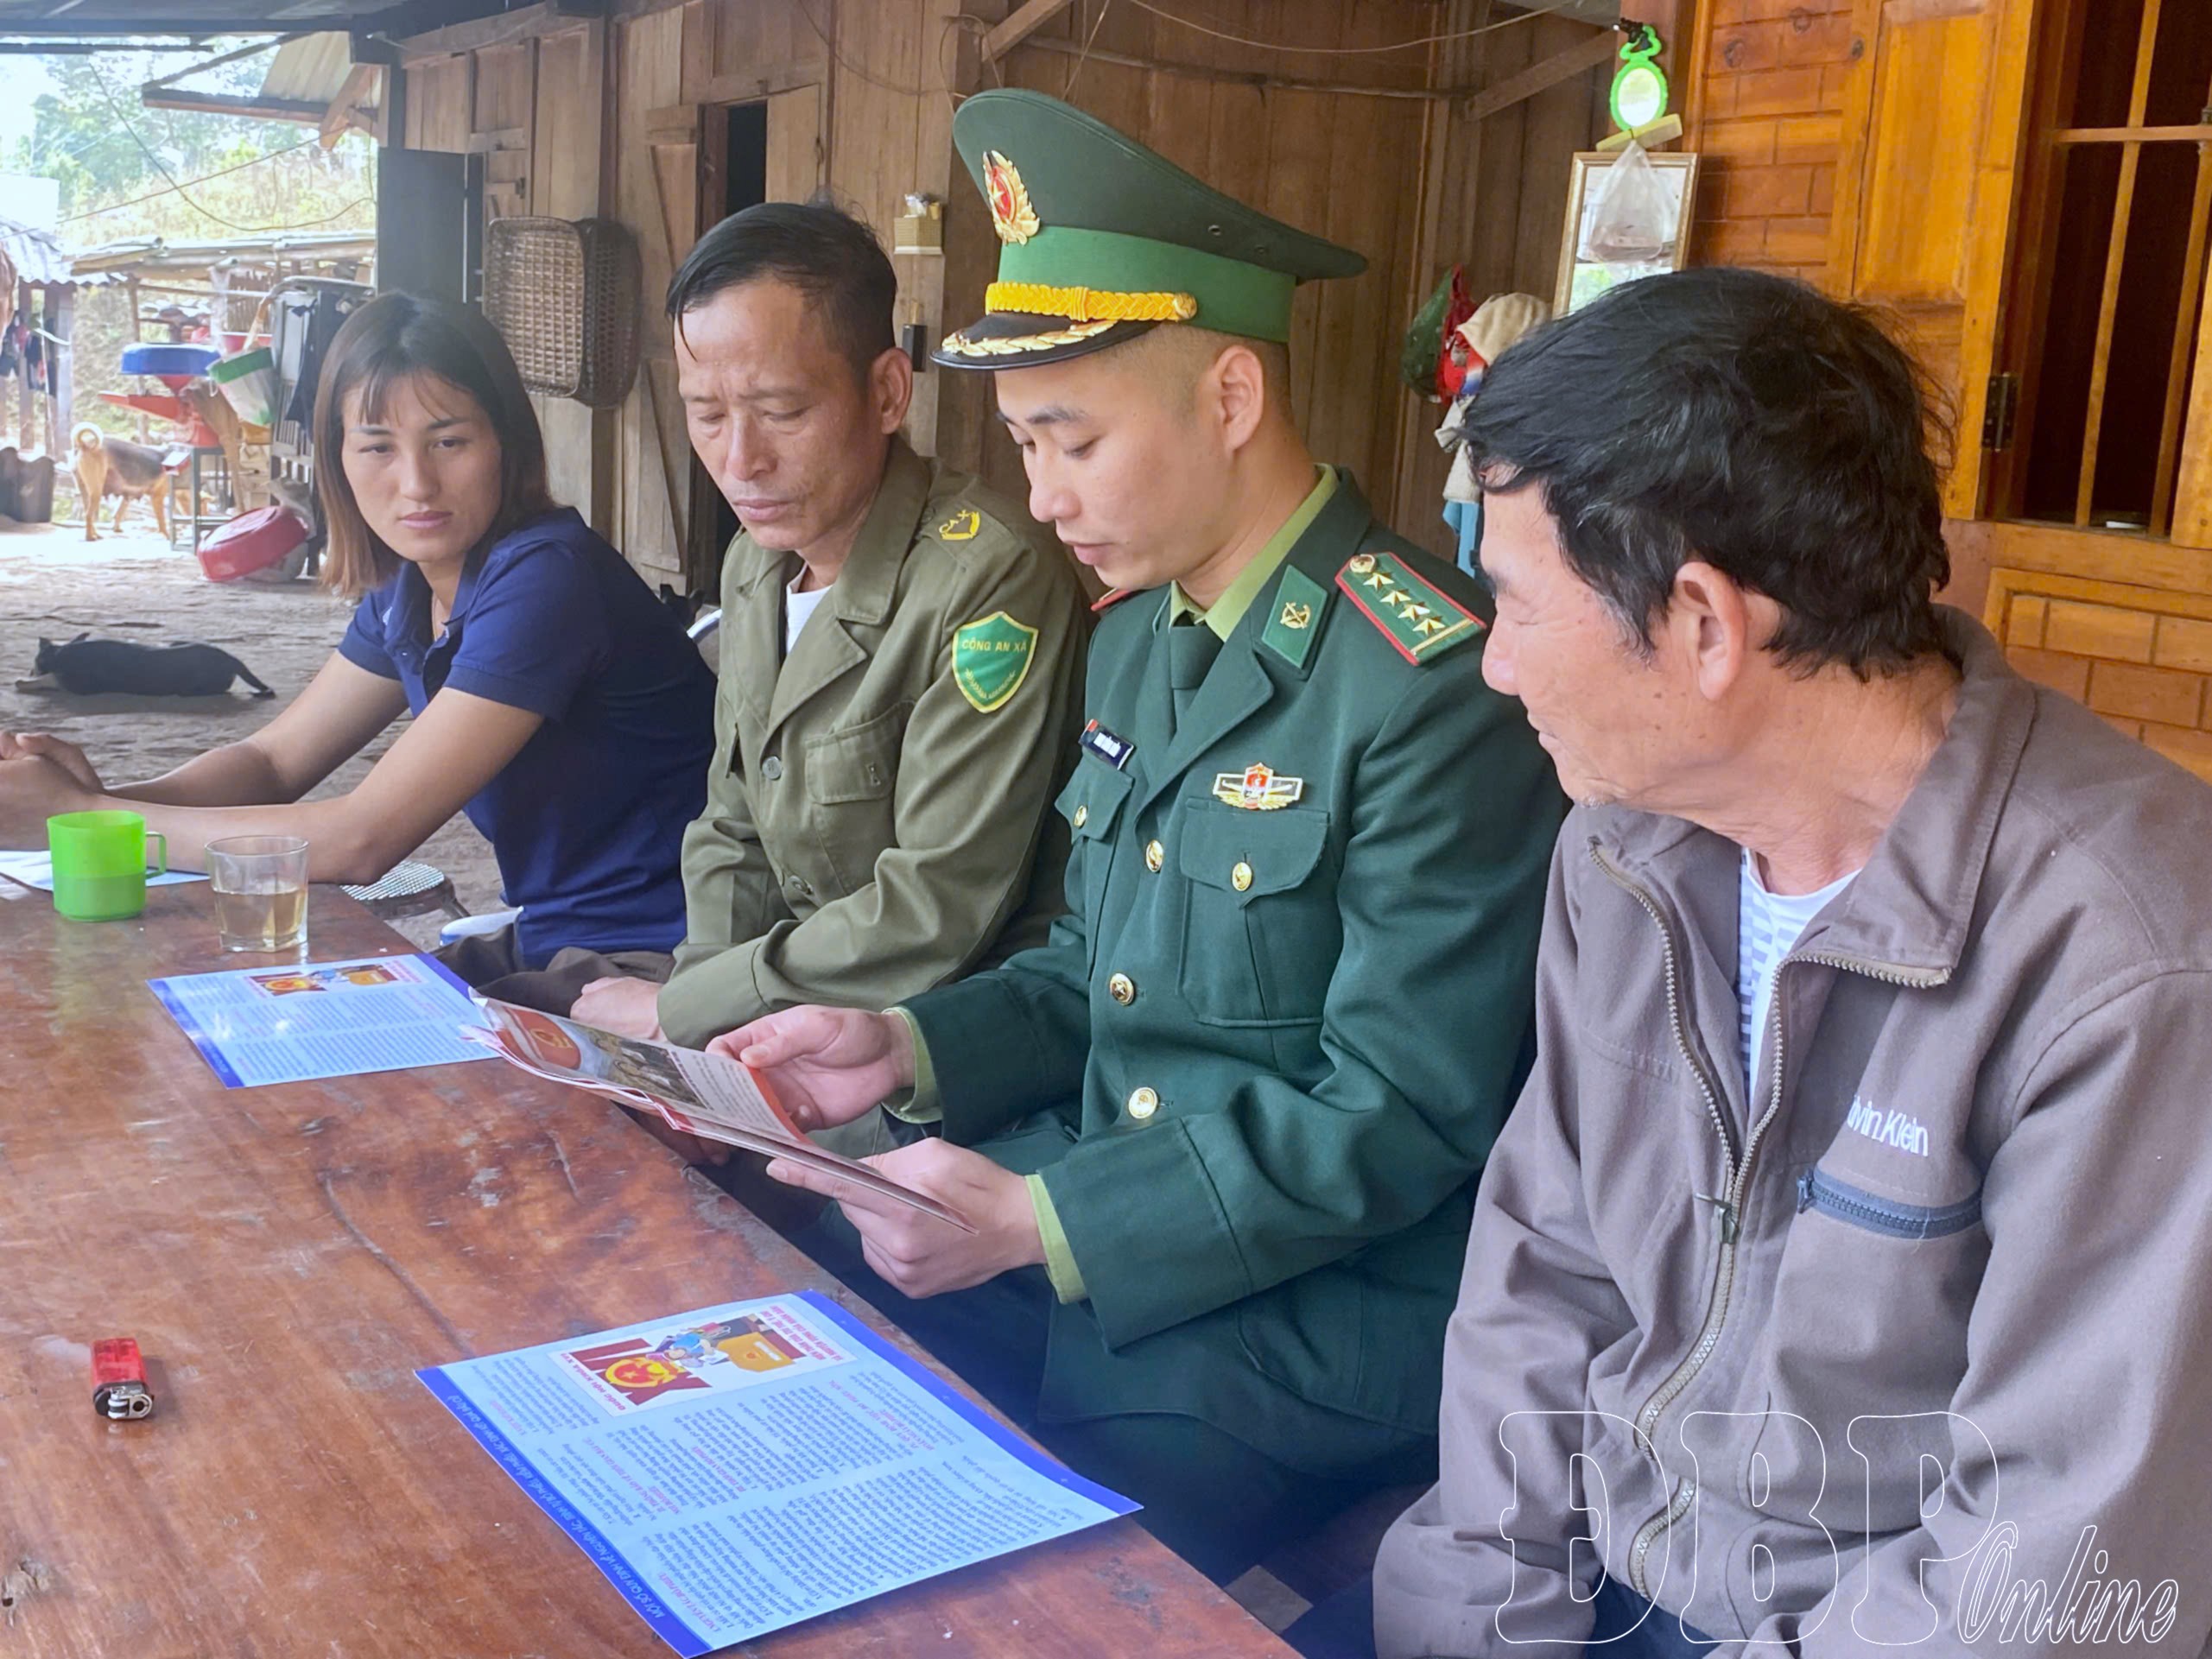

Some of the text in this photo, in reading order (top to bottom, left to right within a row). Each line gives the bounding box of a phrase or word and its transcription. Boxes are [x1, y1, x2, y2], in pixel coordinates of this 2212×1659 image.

[962, 637, 991, 651] CÔNG
[995, 641, 1010, 652] AN
[1879, 1109, 1929, 1157] Klein
